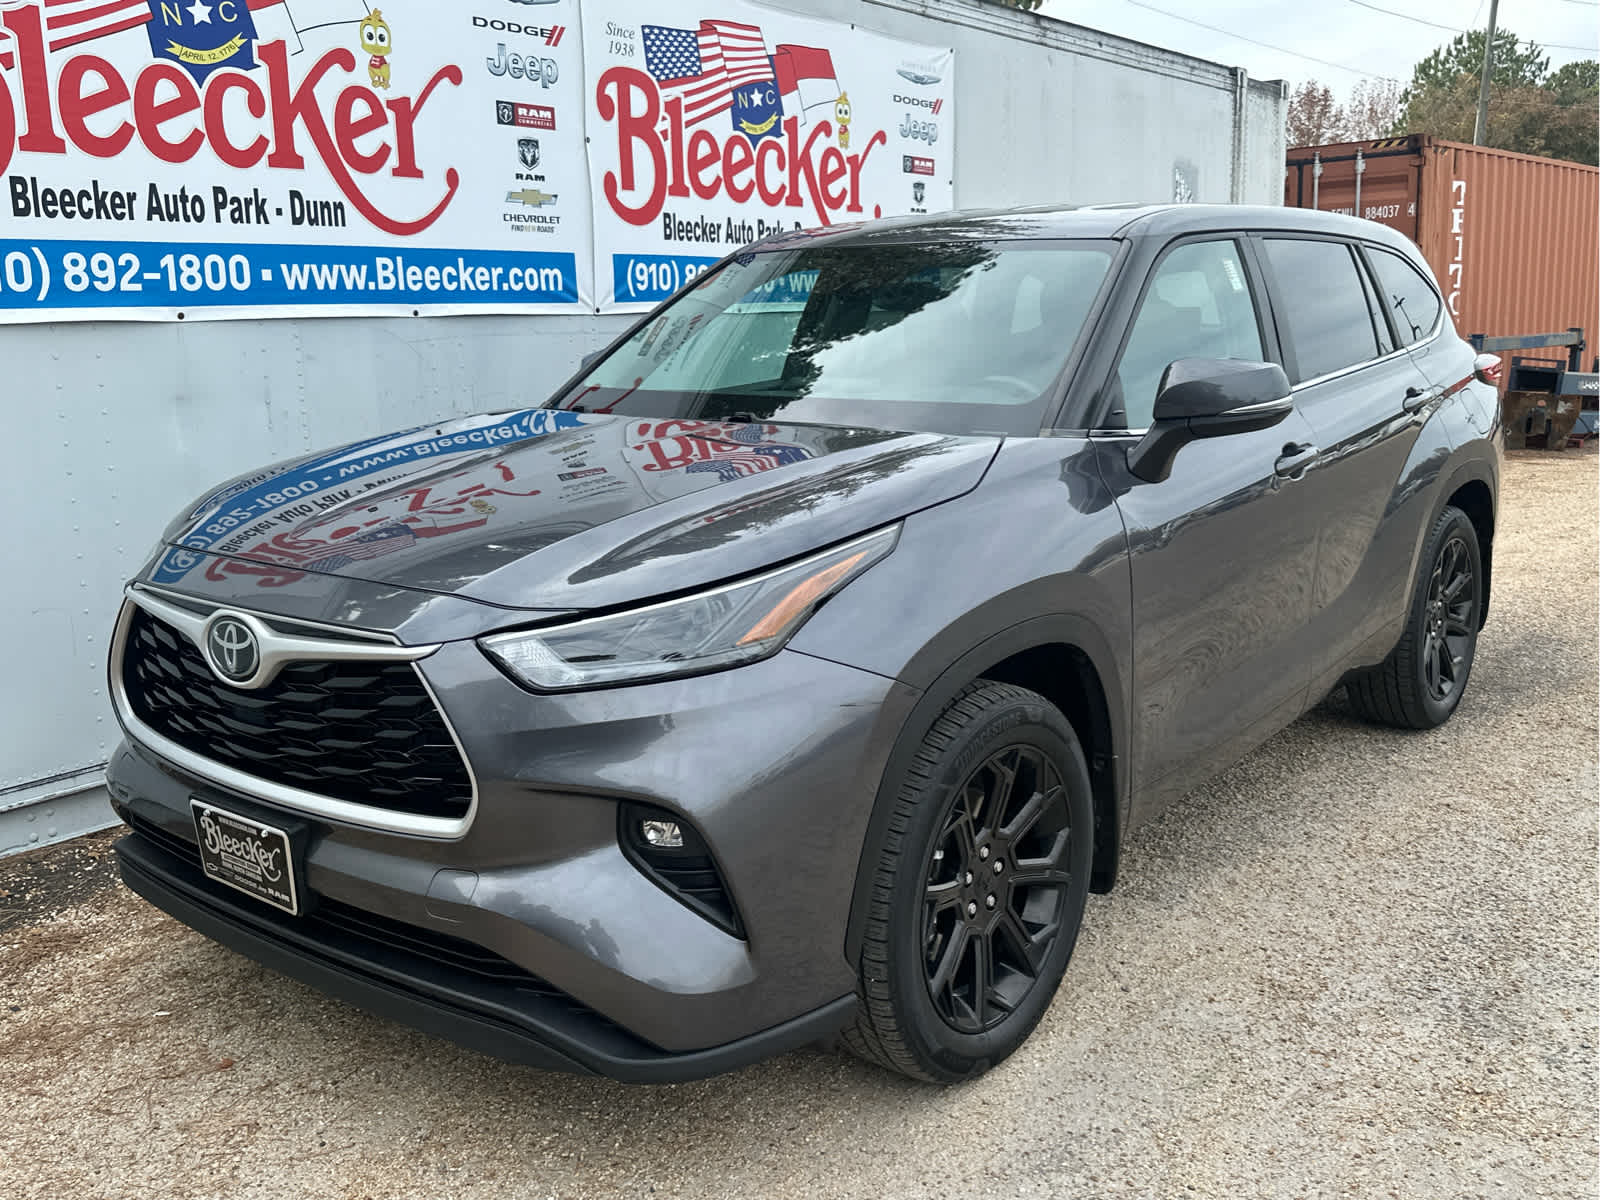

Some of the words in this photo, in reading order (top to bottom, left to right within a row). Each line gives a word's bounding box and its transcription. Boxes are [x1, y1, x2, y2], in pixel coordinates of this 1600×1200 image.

[161, 2, 182, 26] N
[218, 1, 238, 22] C
[472, 16, 553, 39] DODGE
[605, 21, 635, 40] Since
[182, 50, 206, 61] APRIL
[219, 44, 236, 58] 1776
[608, 40, 635, 57] 1938
[486, 43, 559, 89] Jeep
[738, 91, 749, 109] N
[765, 89, 776, 105] C
[893, 94, 937, 109] DODGE
[0, 4, 463, 236] leecker
[517, 107, 553, 119] RAM
[899, 112, 938, 146] Jeep
[596, 66, 887, 226] Bleecker
[515, 172, 546, 182] RAM
[9, 175, 137, 221] Bleecker
[146, 183, 206, 223] Auto
[211, 186, 270, 225] Park
[288, 189, 346, 228] Dunn
[1365, 204, 1400, 220] 884037
[1407, 202, 1417, 216] 4
[503, 213, 561, 225] CHEVROLET
[662, 212, 722, 243] Bleecker
[725, 216, 754, 244] Auto
[61, 251, 251, 293] 892-1800
[280, 255, 563, 293] www.Bleecker.com
[626, 258, 680, 298] (910)
[200, 815, 281, 883] Bleecker
